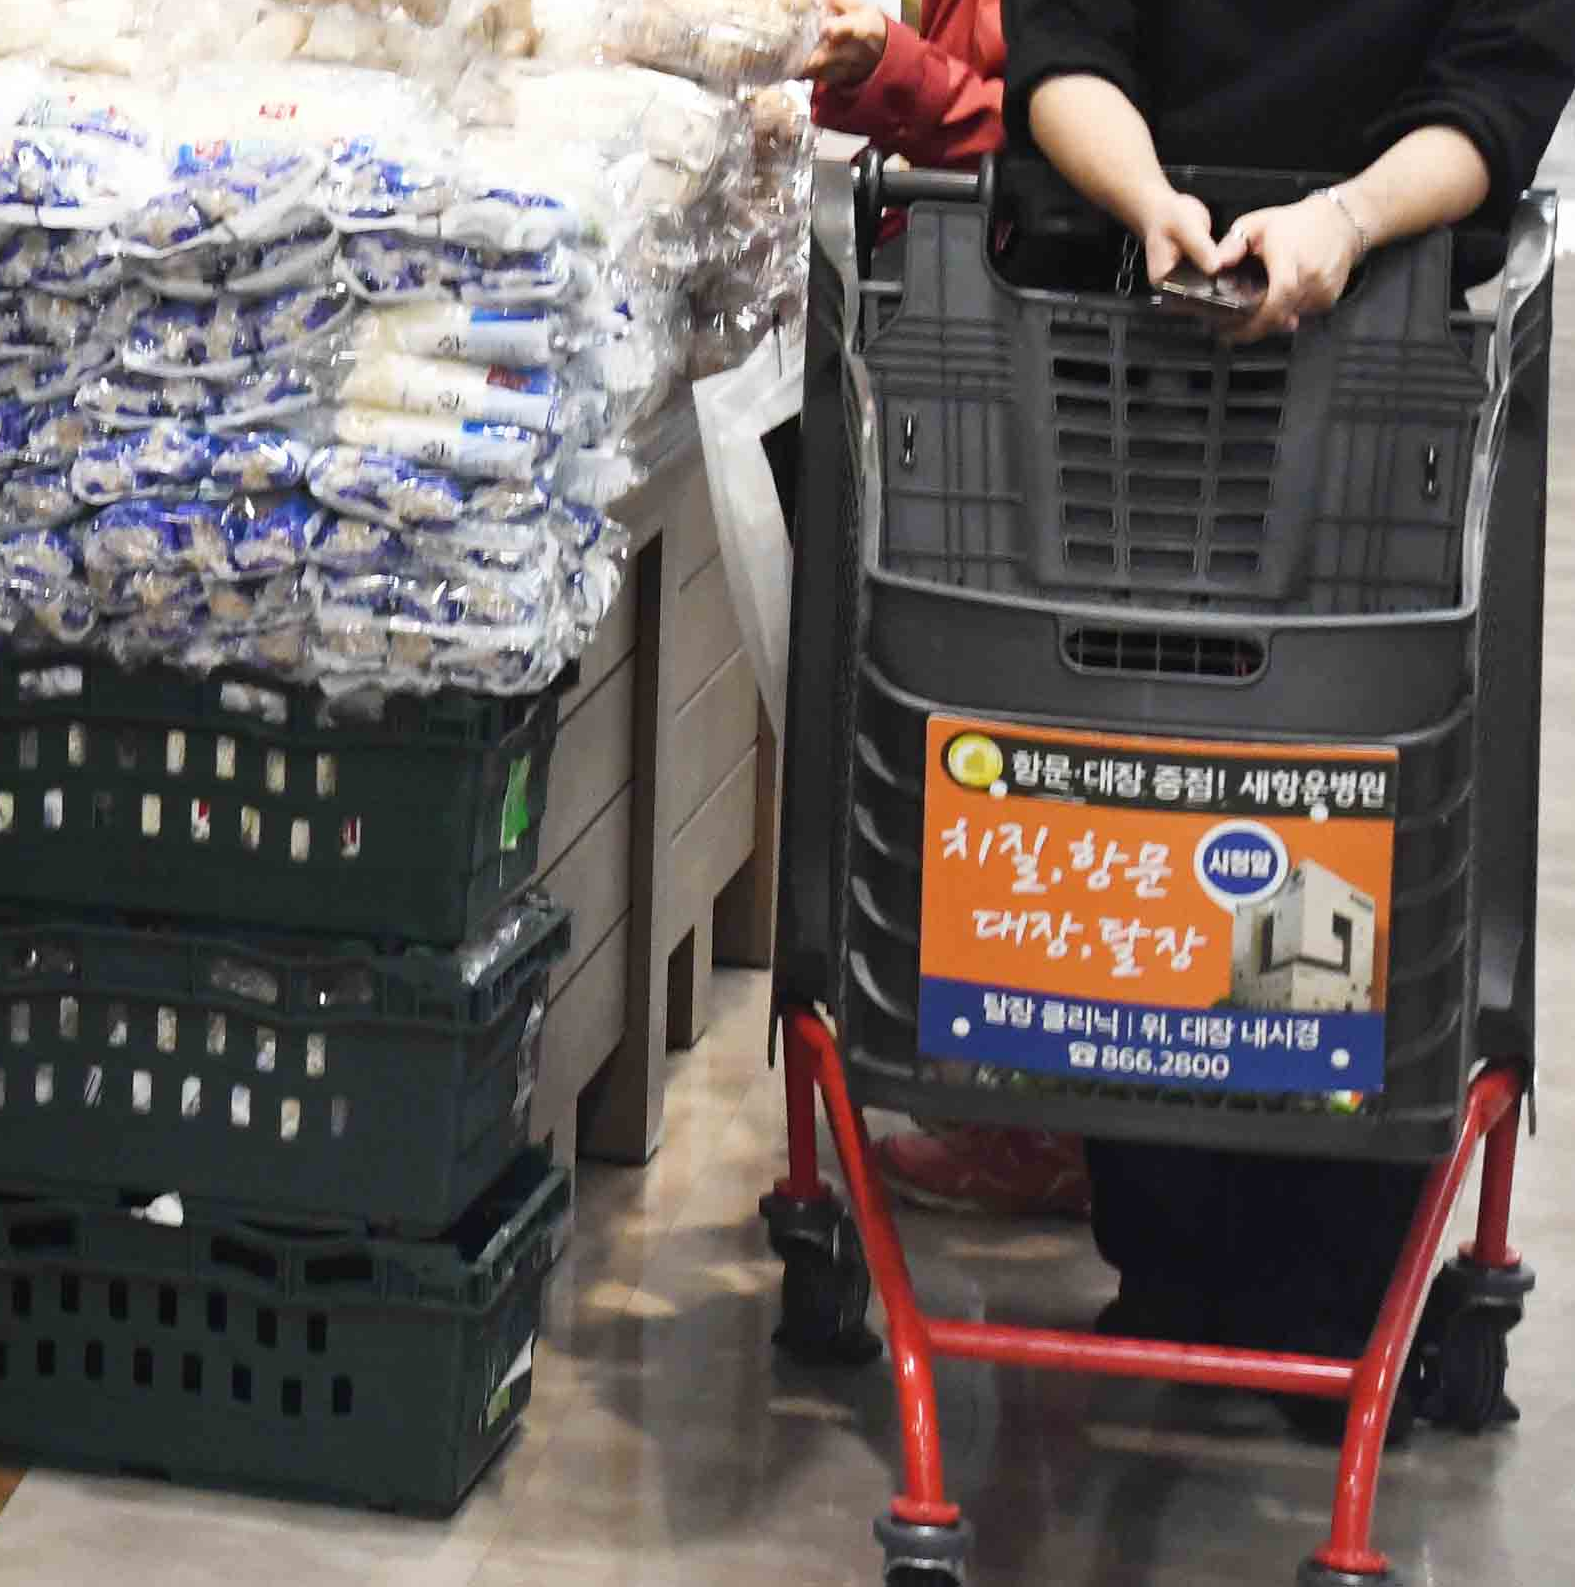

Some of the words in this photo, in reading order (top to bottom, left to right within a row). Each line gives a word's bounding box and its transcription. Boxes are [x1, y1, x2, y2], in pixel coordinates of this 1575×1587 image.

[983, 992, 1033, 1029] 탈장
[1041, 1000, 1119, 1040] 클리닉
[1140, 1013, 1172, 1046] 위,
[1180, 1015, 1234, 1049] 대장
[1240, 1018, 1320, 1051] 내시경
[1101, 1046, 1231, 1080] 866.2800
